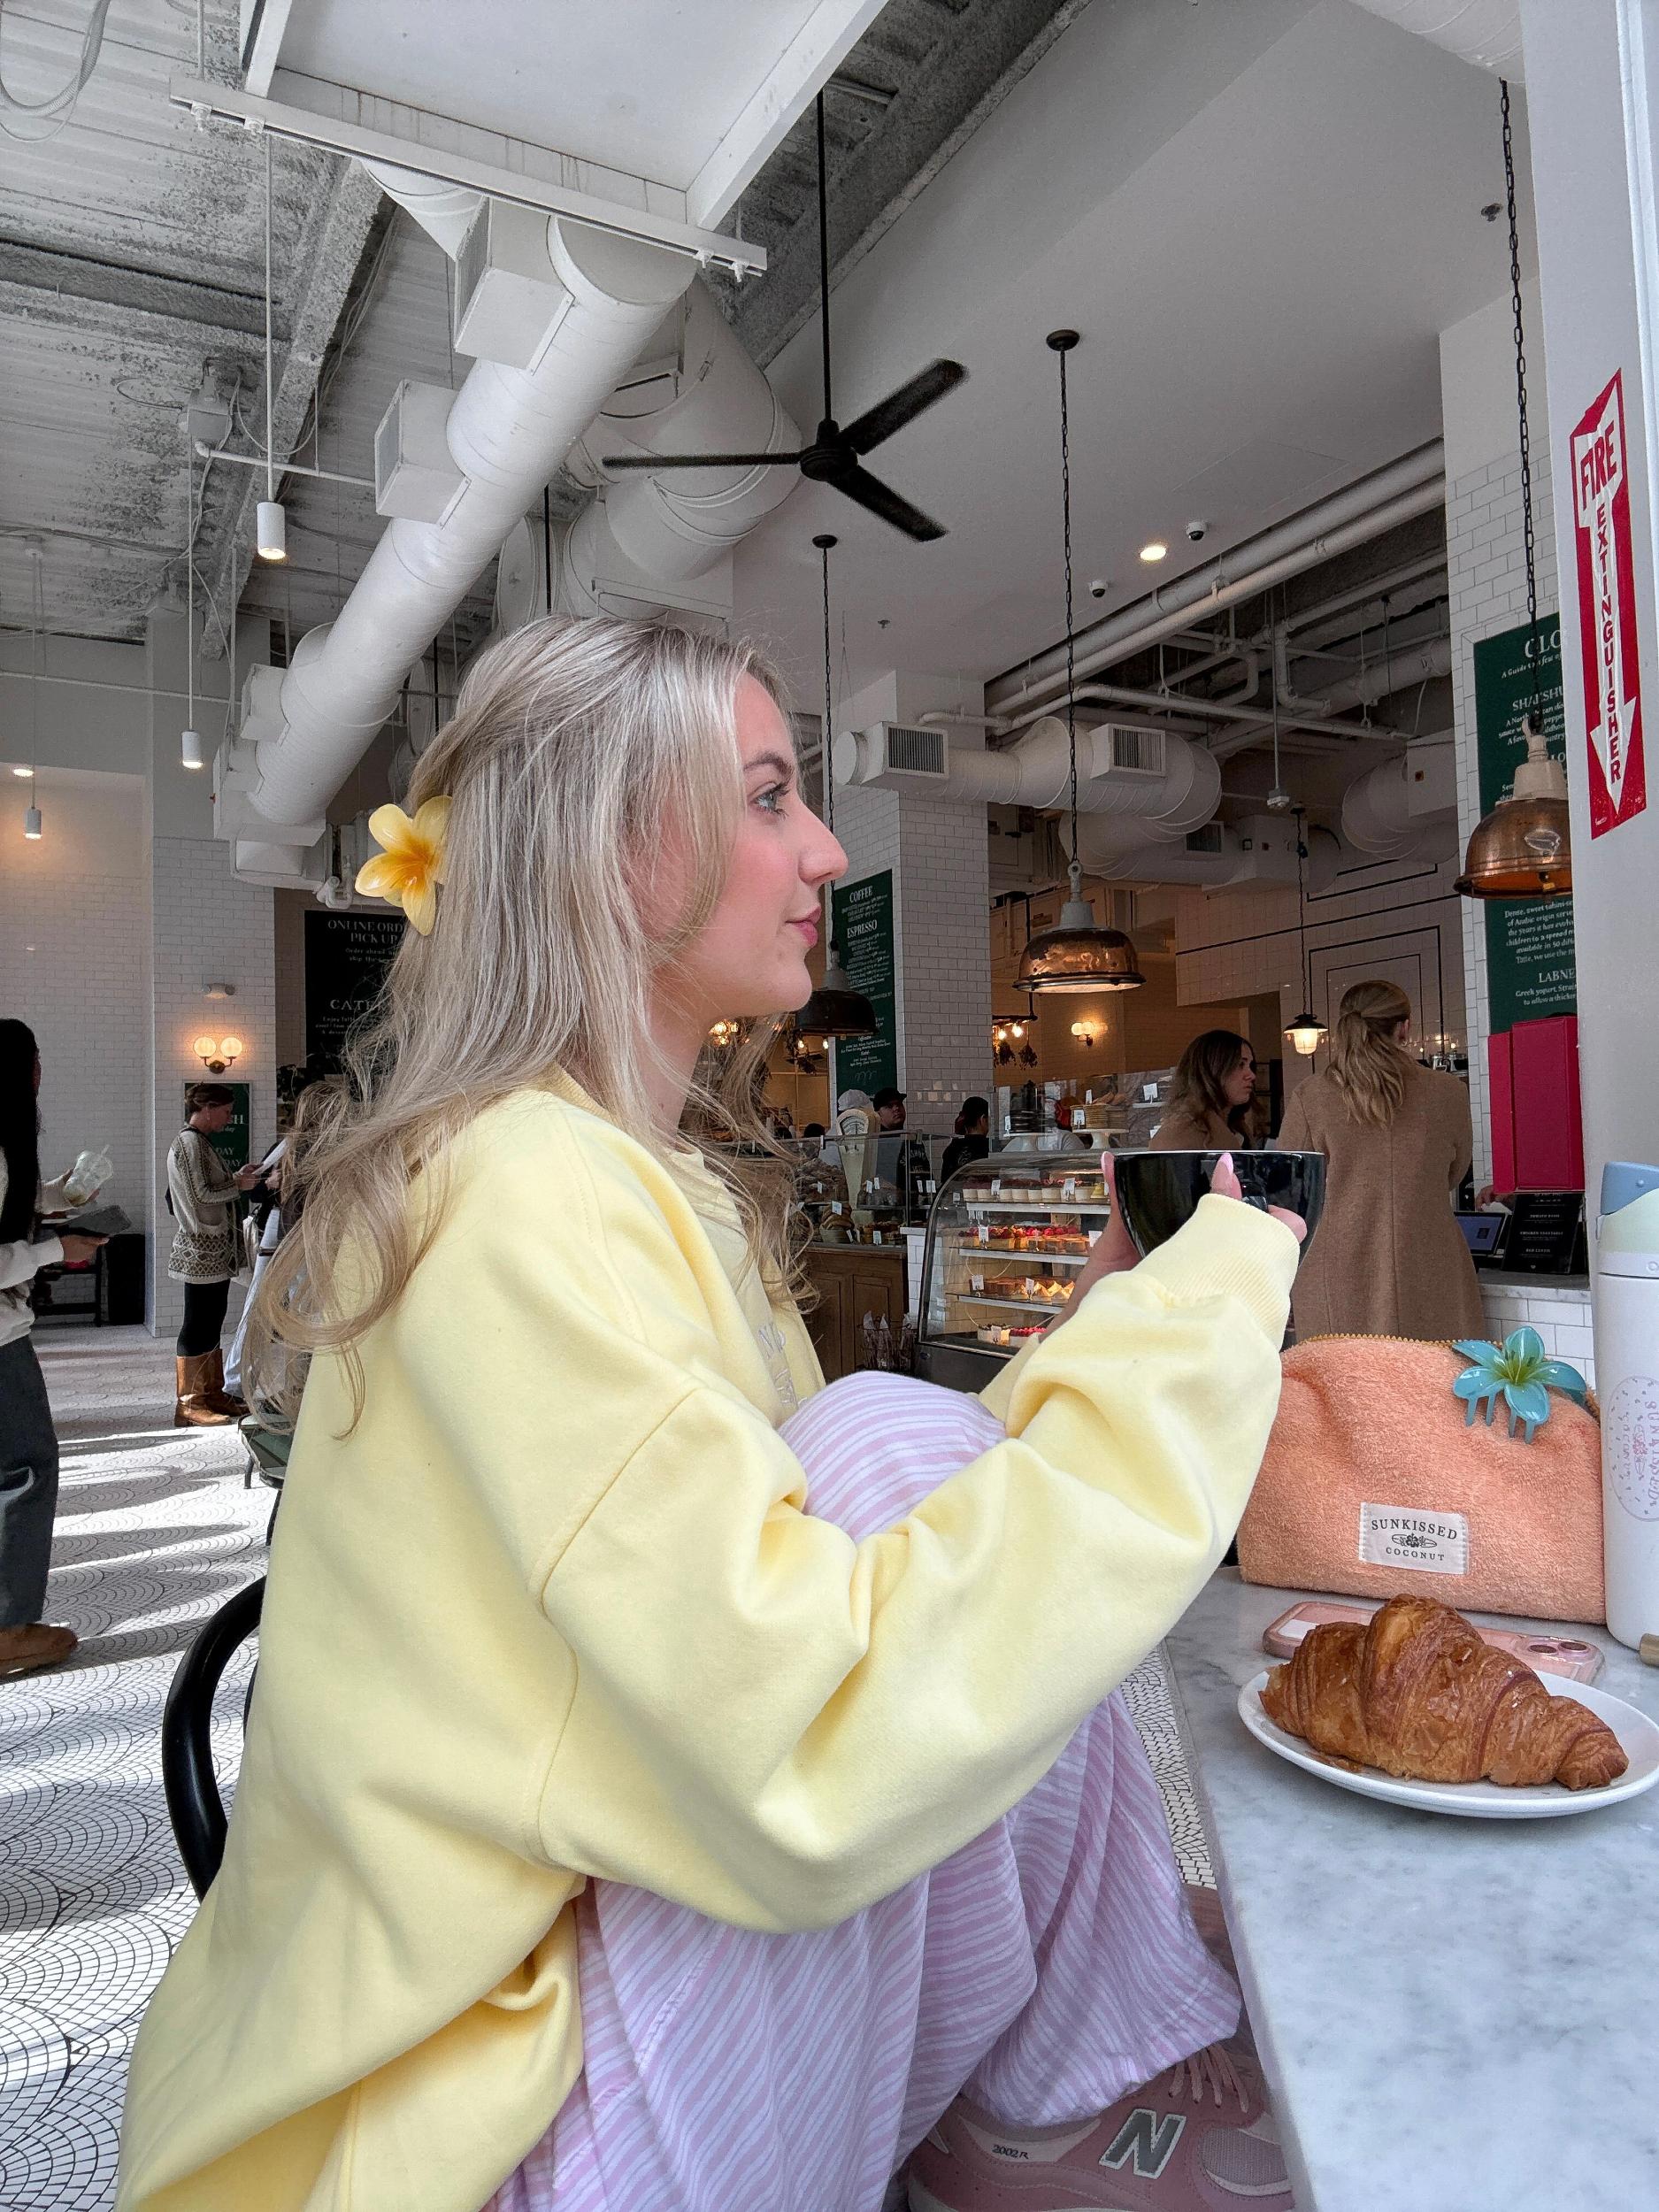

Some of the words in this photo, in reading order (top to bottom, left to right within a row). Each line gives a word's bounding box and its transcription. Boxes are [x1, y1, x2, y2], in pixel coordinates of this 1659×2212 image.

[1580, 420, 1617, 511] FIRE
[1596, 503, 1622, 785] EXTINGUISHER
[1508, 664, 1527, 676] Guide
[849, 886, 873, 902] COFFEE
[327, 919, 375, 931] ONLINE
[847, 919, 878, 939] ESPRESSO
[1518, 926, 1536, 936] years
[350, 933, 379, 943] PICK
[1545, 929, 1568, 941] spread
[1516, 987, 1535, 997] Greek
[1371, 1518, 1458, 1540] SUNKISSED
[1386, 1547, 1445, 1561] COCONUT
[1099, 2108, 1187, 2179] N
